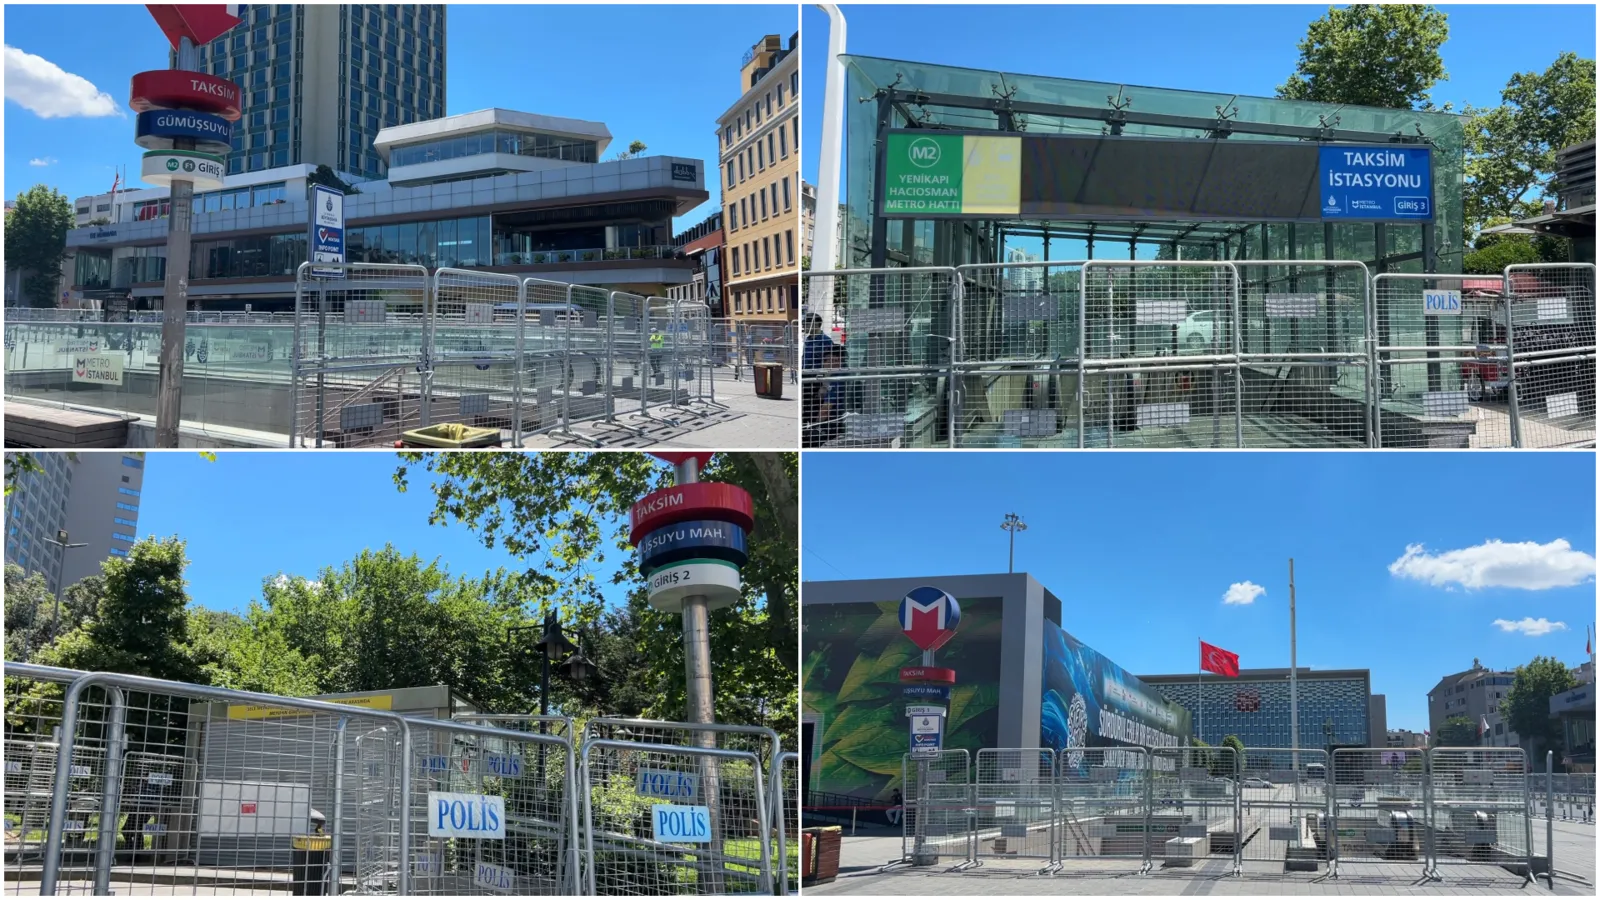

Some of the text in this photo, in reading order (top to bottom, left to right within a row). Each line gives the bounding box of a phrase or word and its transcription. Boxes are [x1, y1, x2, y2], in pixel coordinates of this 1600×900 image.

[190, 79, 235, 100] TAKSİM
[157, 114, 228, 136] GÜMÜŞSUYU
[912, 146, 937, 160] M2
[1344, 150, 1405, 167] TAKSİM
[198, 162, 221, 178] GİRİŞ
[899, 173, 949, 184] YENİKAPI
[1329, 169, 1421, 188] İSTASYONU
[889, 187, 958, 197] HACIOSMAN
[886, 199, 960, 209] METRO HATTI
[1397, 200, 1419, 211] GİRİŞ
[1426, 291, 1459, 310] POLİS
[86, 358, 110, 368] METRO
[86, 368, 119, 380] İSTANBUL
[636, 493, 684, 520] TAKSİM
[689, 527, 727, 539] MAH.
[654, 570, 691, 589] GİRİŞ 2
[487, 751, 520, 776] POLİS
[640, 771, 693, 796] POLİS
[437, 795, 499, 831] POLİS
[657, 806, 706, 836] POLİS
[477, 864, 510, 889] POLİS
